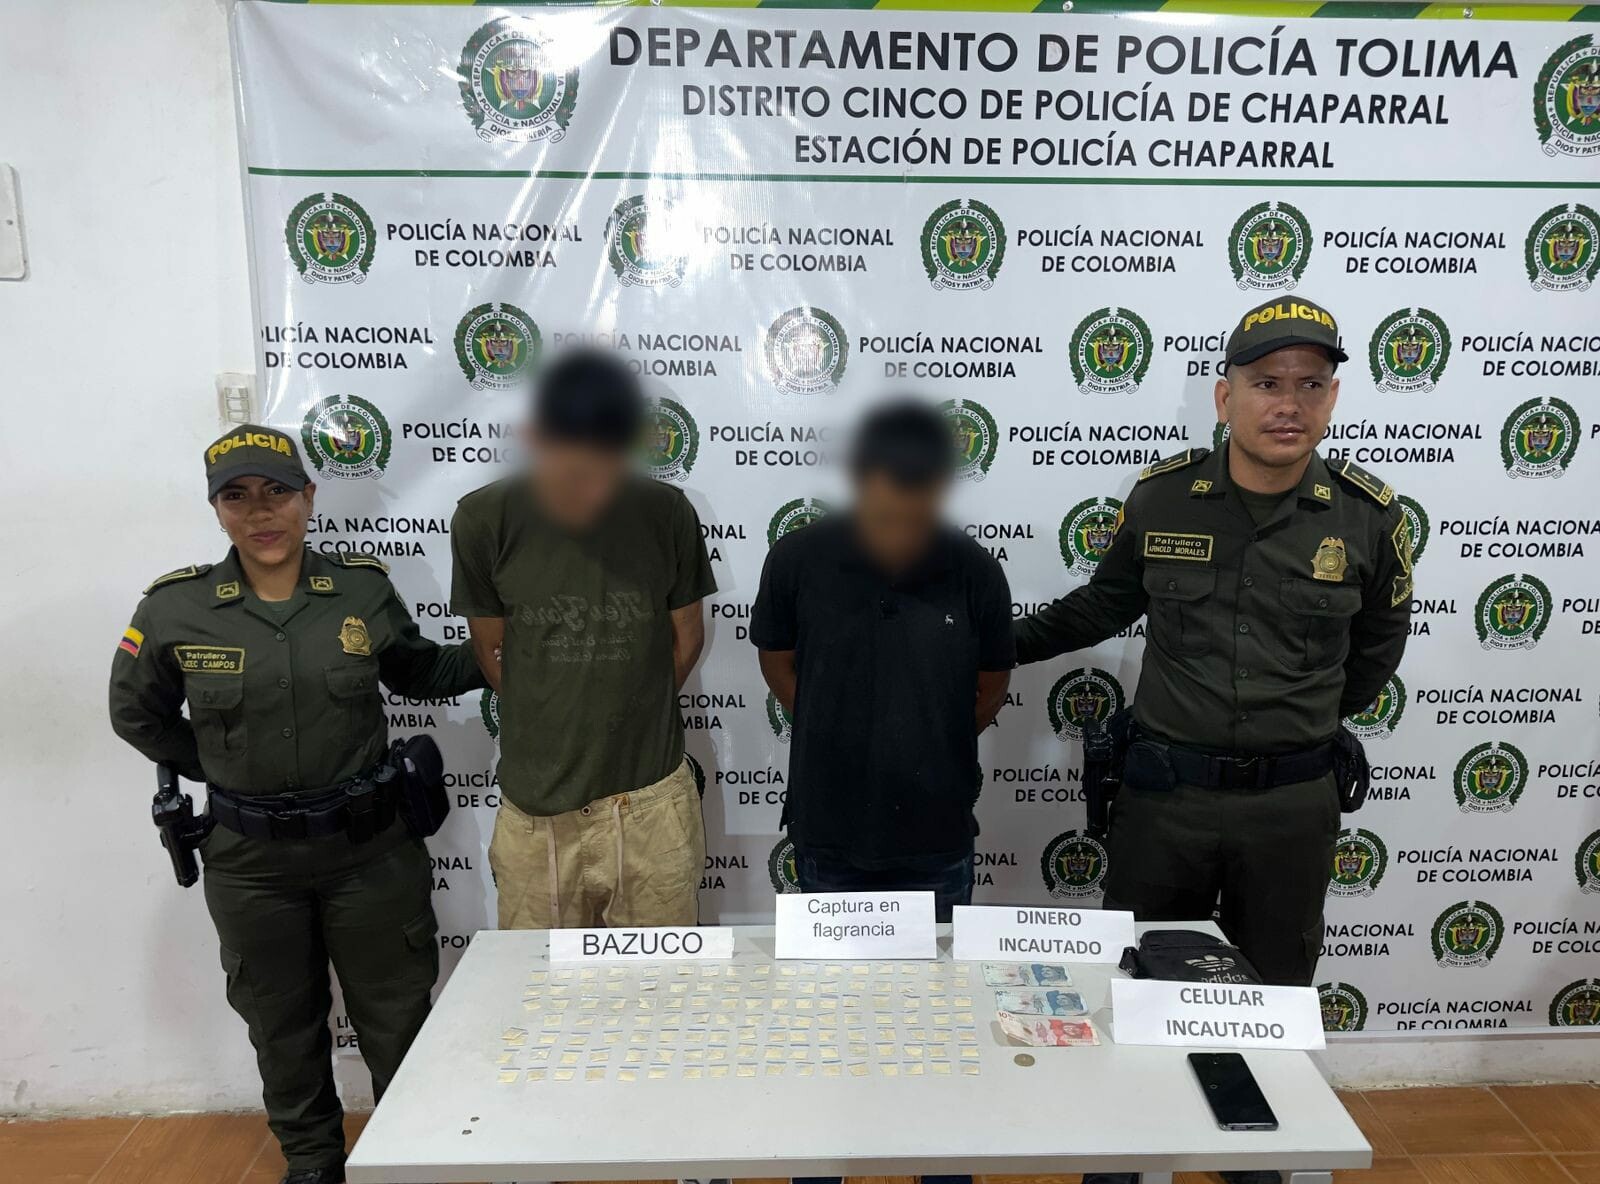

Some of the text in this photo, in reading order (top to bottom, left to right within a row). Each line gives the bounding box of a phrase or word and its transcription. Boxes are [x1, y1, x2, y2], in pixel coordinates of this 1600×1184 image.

[610, 25, 1518, 78] DEPARTAMENTO DE POLICÍA TOLIMA
[683, 82, 1448, 124] DISTRITO CINCO DE POLICÍA DE CHAPARRAL
[796, 128, 1333, 168] ESTACIÓN DE POLICÍA CHAPARRAL
[387, 219, 582, 241] POLICÍA NACIONAL
[789, 228, 893, 245] NACIONAL
[1018, 225, 1203, 247] POLICÍA NACIONAL
[1324, 227, 1505, 248] POLICÍA NACIONAL
[416, 250, 556, 267] DE COLOMBIA
[731, 254, 866, 271] DE COLOMBIA
[1042, 256, 1175, 272] DE COLOMBIA
[1346, 257, 1476, 273] DE COLOMBIA
[1244, 303, 1335, 332] POLICIA
[261, 322, 433, 343] LICÍA NACIONAL
[638, 334, 741, 351] NACIONAL
[860, 332, 1042, 353] POLICÍA NACIONAL
[1164, 331, 1226, 352] POLICÍ
[1462, 332, 1600, 352] POLICÍA NACIO
[298, 352, 407, 368] COLOMBIA
[628, 359, 717, 376] OLOMBIA
[1483, 360, 1600, 376] DE COLOMBI
[885, 362, 1016, 378] DE COLOMBIA
[1187, 361, 1209, 376] DE
[403, 418, 481, 438] POLICÍA
[710, 422, 784, 442] POLICÍA
[1010, 422, 1189, 442] POLICÍA NACIONAL
[1322, 419, 1481, 440] OLICÍA NACIONAL
[207, 433, 292, 465] POLICIA
[433, 447, 456, 462] DE
[1033, 449, 1161, 465] DE COLOMBIA
[1356, 448, 1454, 463] COLOMBIA
[736, 451, 757, 465] DE
[345, 518, 449, 533] NACIONAL
[701, 524, 746, 539] ONAL
[964, 524, 1034, 539] CIONAL
[1440, 516, 1600, 535] POLICÍA NACIONA
[1461, 543, 1583, 557] DE COLOMBIA
[711, 604, 749, 618] POLI
[1411, 600, 1457, 614] ONAL
[1562, 599, 1600, 613] POLI
[444, 626, 466, 640] DE
[678, 694, 746, 708] CIONAL
[1417, 685, 1582, 703] POLICÍA NACIONAL
[681, 715, 722, 729] MBIA
[1437, 710, 1555, 724] DE COLOMBIA
[442, 770, 499, 787] OLICÍA
[715, 767, 784, 784] POLICÍA
[994, 765, 1060, 782] POLICÍA
[1371, 766, 1436, 780] CIONAL
[740, 792, 759, 804] DE
[1016, 789, 1035, 802] DE
[1368, 787, 1410, 800] MBIA
[1558, 785, 1578, 798] DE
[457, 795, 479, 807] DE
[705, 856, 748, 869] ONAL
[973, 853, 1017, 866] ONAL
[1398, 846, 1558, 863] POLICÍA NACIONAL
[430, 857, 472, 870] ONAL
[1417, 869, 1532, 882] DE COLOMBIA
[808, 899, 899, 916] Captura en
[1017, 911, 1081, 926] DINERO
[1514, 918, 1578, 934] POLICÍA
[813, 921, 894, 940] flagrancia
[1326, 924, 1414, 937] NACIONAL
[583, 932, 702, 955] BAZUCO
[1000, 938, 1101, 955] INCAUTADO
[1320, 943, 1390, 956] OLOMBIA
[1533, 941, 1600, 953] DE COLO
[1180, 988, 1264, 1006] CELULAR
[1378, 999, 1532, 1014] POLICÍA NACIONAL
[1167, 1020, 1284, 1039] INCAUTADO
